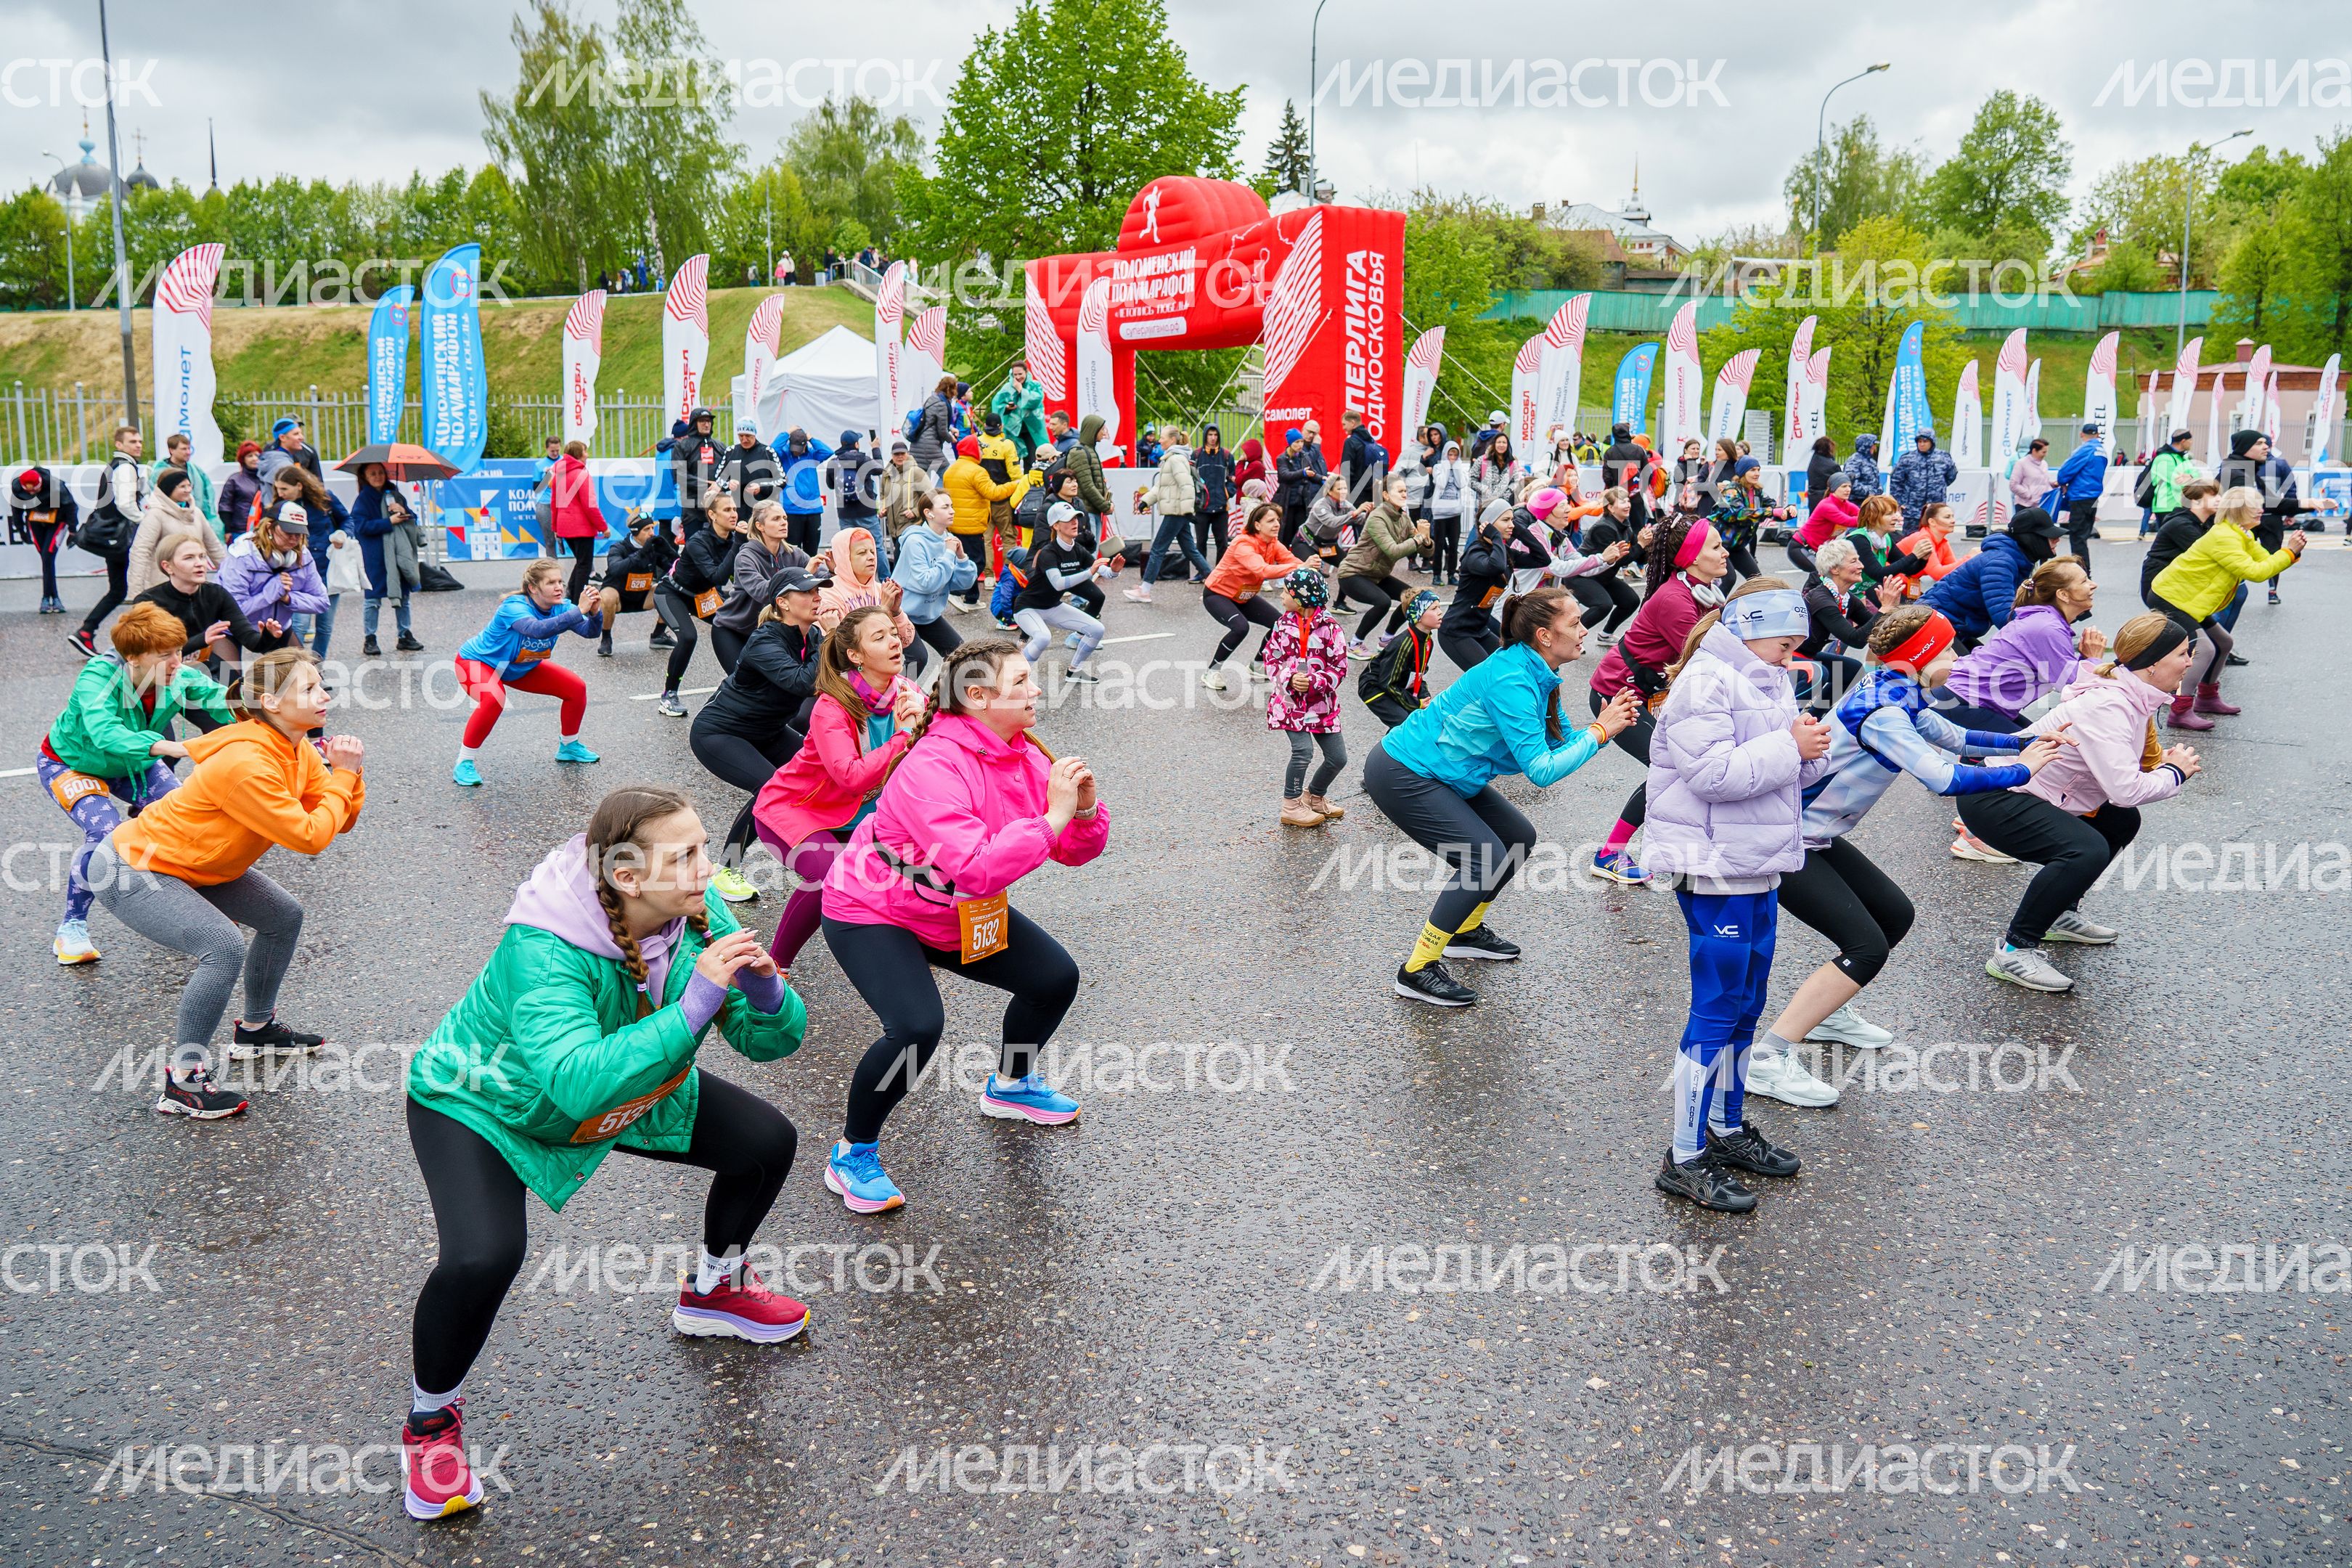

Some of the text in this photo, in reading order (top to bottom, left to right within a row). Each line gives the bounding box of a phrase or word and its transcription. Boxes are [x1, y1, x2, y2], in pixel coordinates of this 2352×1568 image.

[1113, 245, 1196, 280] КОЛОМЕНСКИЙ
[1112, 272, 1194, 304] ПОЛУМАРАФОН
[1344, 250, 1368, 414] ПЕРЛИГА
[1368, 251, 1386, 441] ОДМОСКОВЬЯ
[430, 314, 449, 446] КОЛОМЕНСКИЙ
[447, 313, 466, 446] ПОЛУМАРАФОН
[1522, 391, 1531, 441] МОСОБЛ
[973, 918, 1000, 950] 5132
[1713, 924, 1739, 935] VC
[1691, 1069, 1702, 1103] VICTORY
